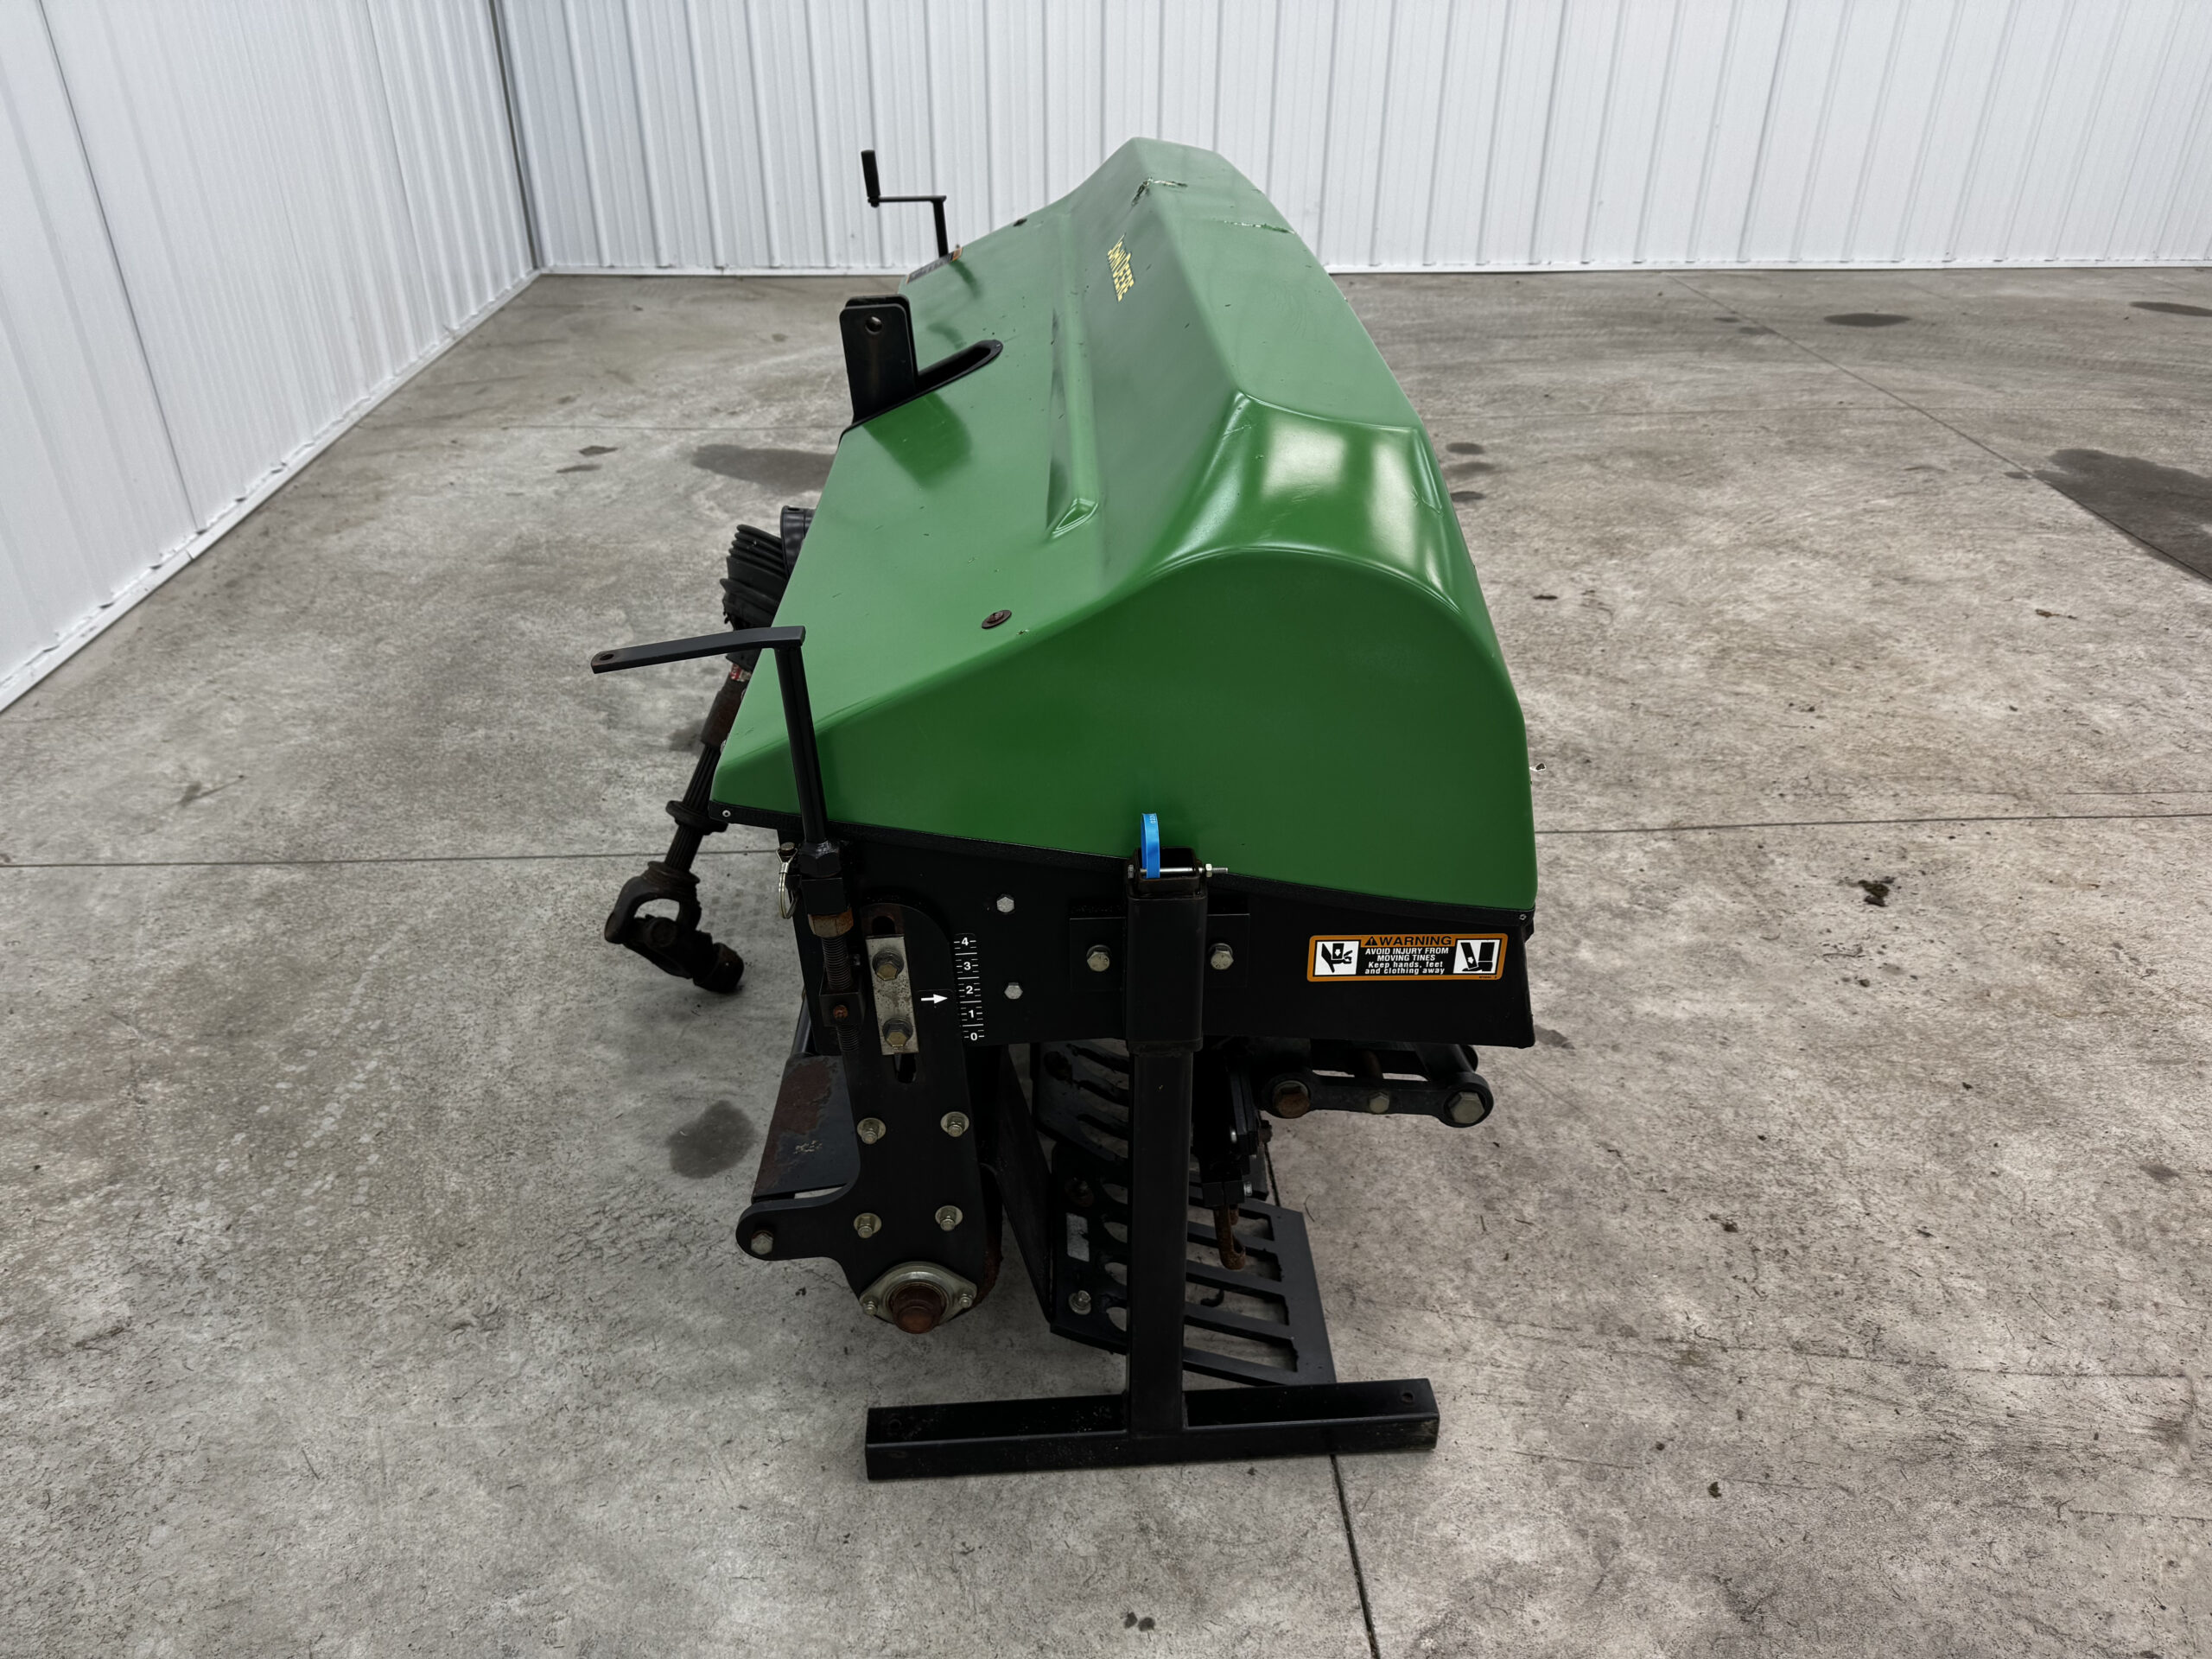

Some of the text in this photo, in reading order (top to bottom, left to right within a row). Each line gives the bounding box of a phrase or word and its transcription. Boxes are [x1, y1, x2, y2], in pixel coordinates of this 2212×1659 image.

[1112, 252, 1135, 302] DEERE
[961, 937, 969, 946] 4
[1379, 936, 1452, 945] WARNING
[963, 961, 971, 970] 3
[965, 985, 974, 995] 2
[968, 1009, 975, 1019] 1
[969, 1032, 978, 1041] 0
